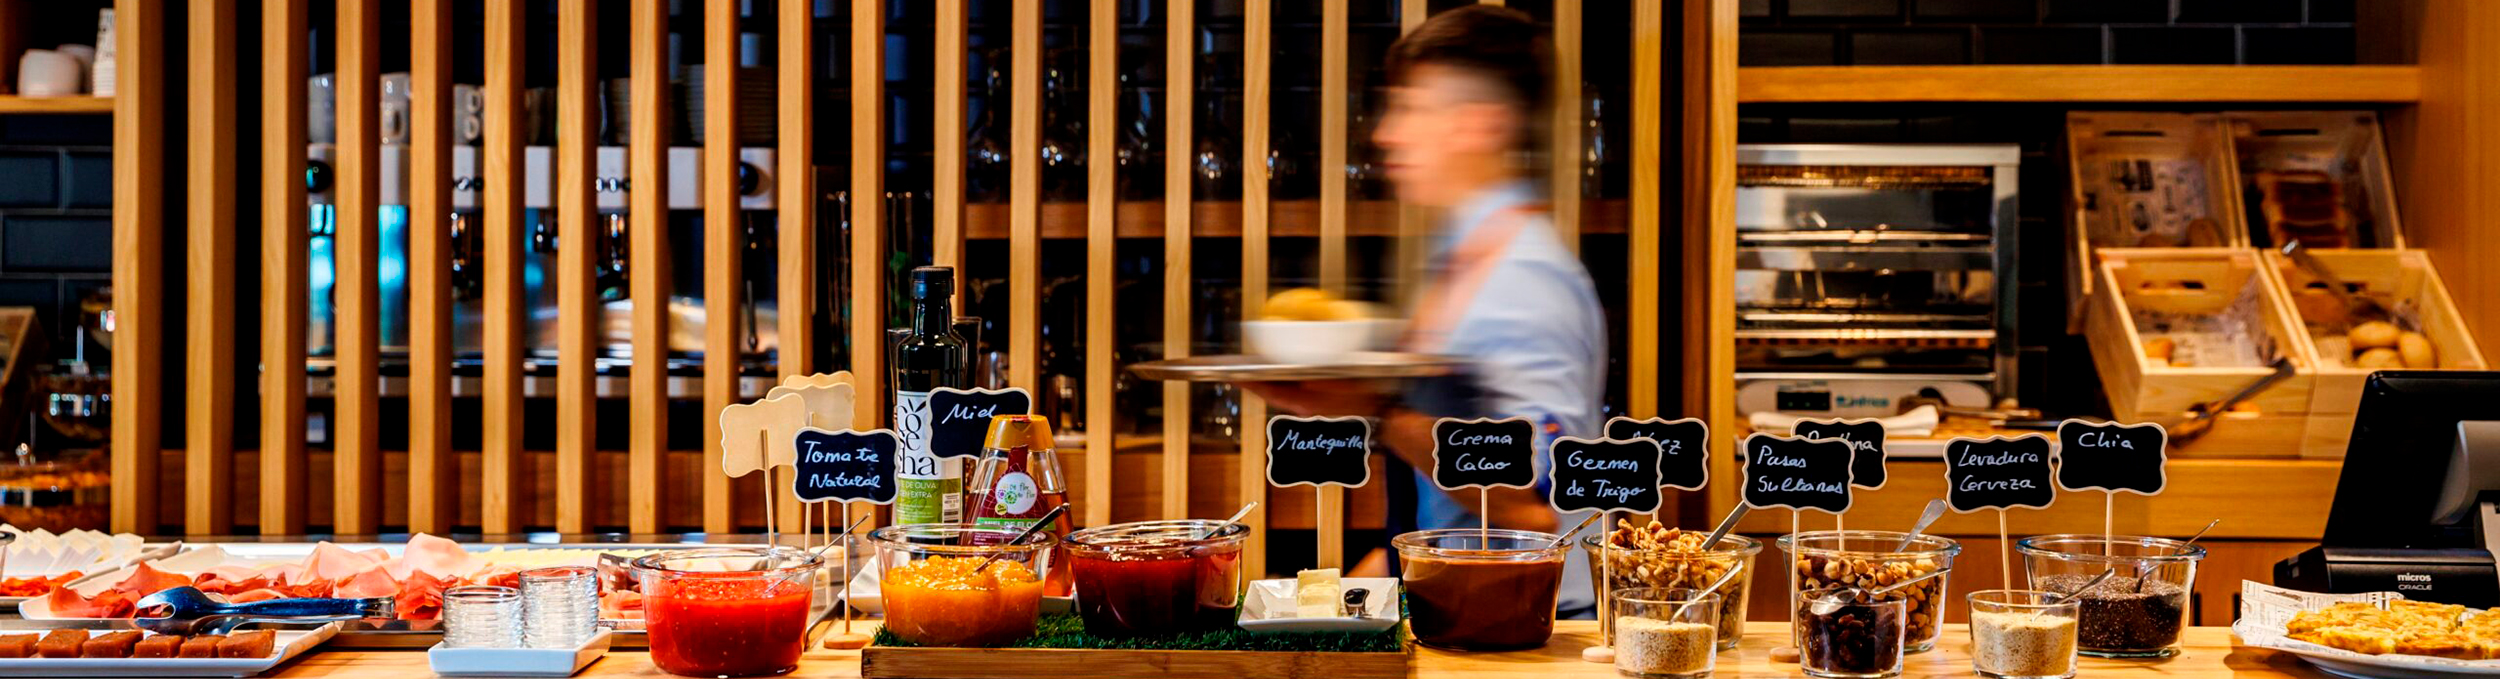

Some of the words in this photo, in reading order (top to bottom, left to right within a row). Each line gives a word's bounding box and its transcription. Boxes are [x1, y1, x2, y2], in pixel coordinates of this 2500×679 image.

[941, 403, 997, 424] Miel
[1277, 429, 1363, 455] Mantequilla
[1448, 429, 1513, 446] Crema
[2078, 431, 2134, 450] Chia
[804, 440, 880, 464] Tomate
[1567, 450, 1639, 473] Germen
[1757, 445, 1807, 468] Pasas
[1958, 441, 2039, 467] Levadura
[1455, 453, 1511, 472] Cacao
[809, 471, 881, 489] Natural
[1758, 475, 1843, 495] Sultanas
[1959, 474, 2036, 492] Cerveza
[1566, 479, 1585, 497] de
[1592, 479, 1647, 504] Trigo
[2396, 572, 2432, 582] micros
